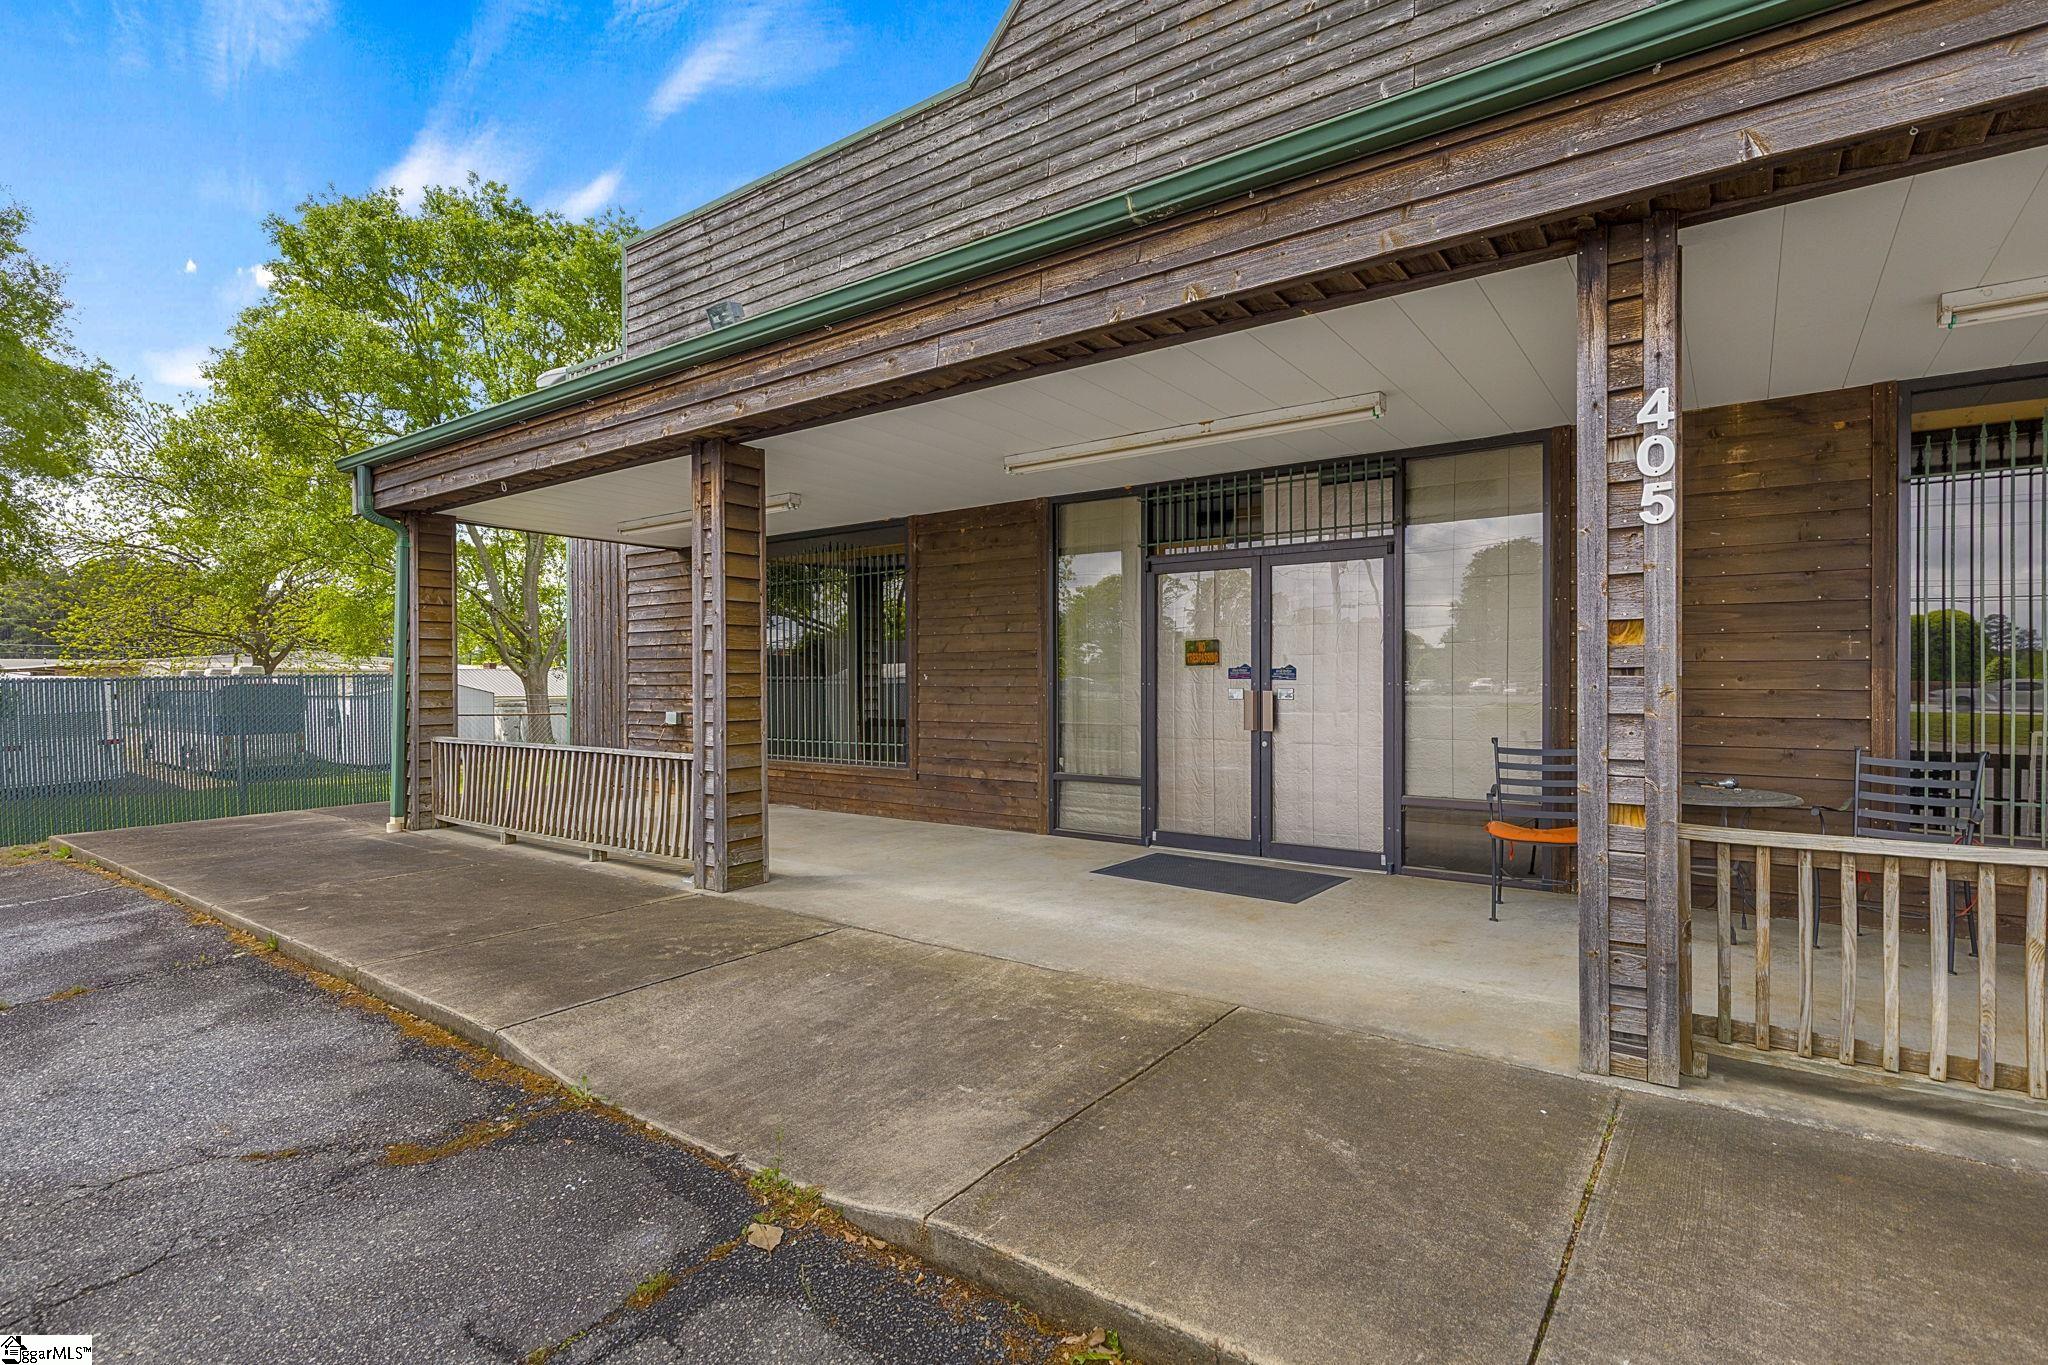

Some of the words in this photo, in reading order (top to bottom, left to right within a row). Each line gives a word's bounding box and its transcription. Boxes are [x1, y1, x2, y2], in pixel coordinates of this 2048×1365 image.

[1636, 387, 1676, 525] 405
[1196, 641, 1206, 652] NO
[1186, 652, 1219, 663] TRESPASSING
